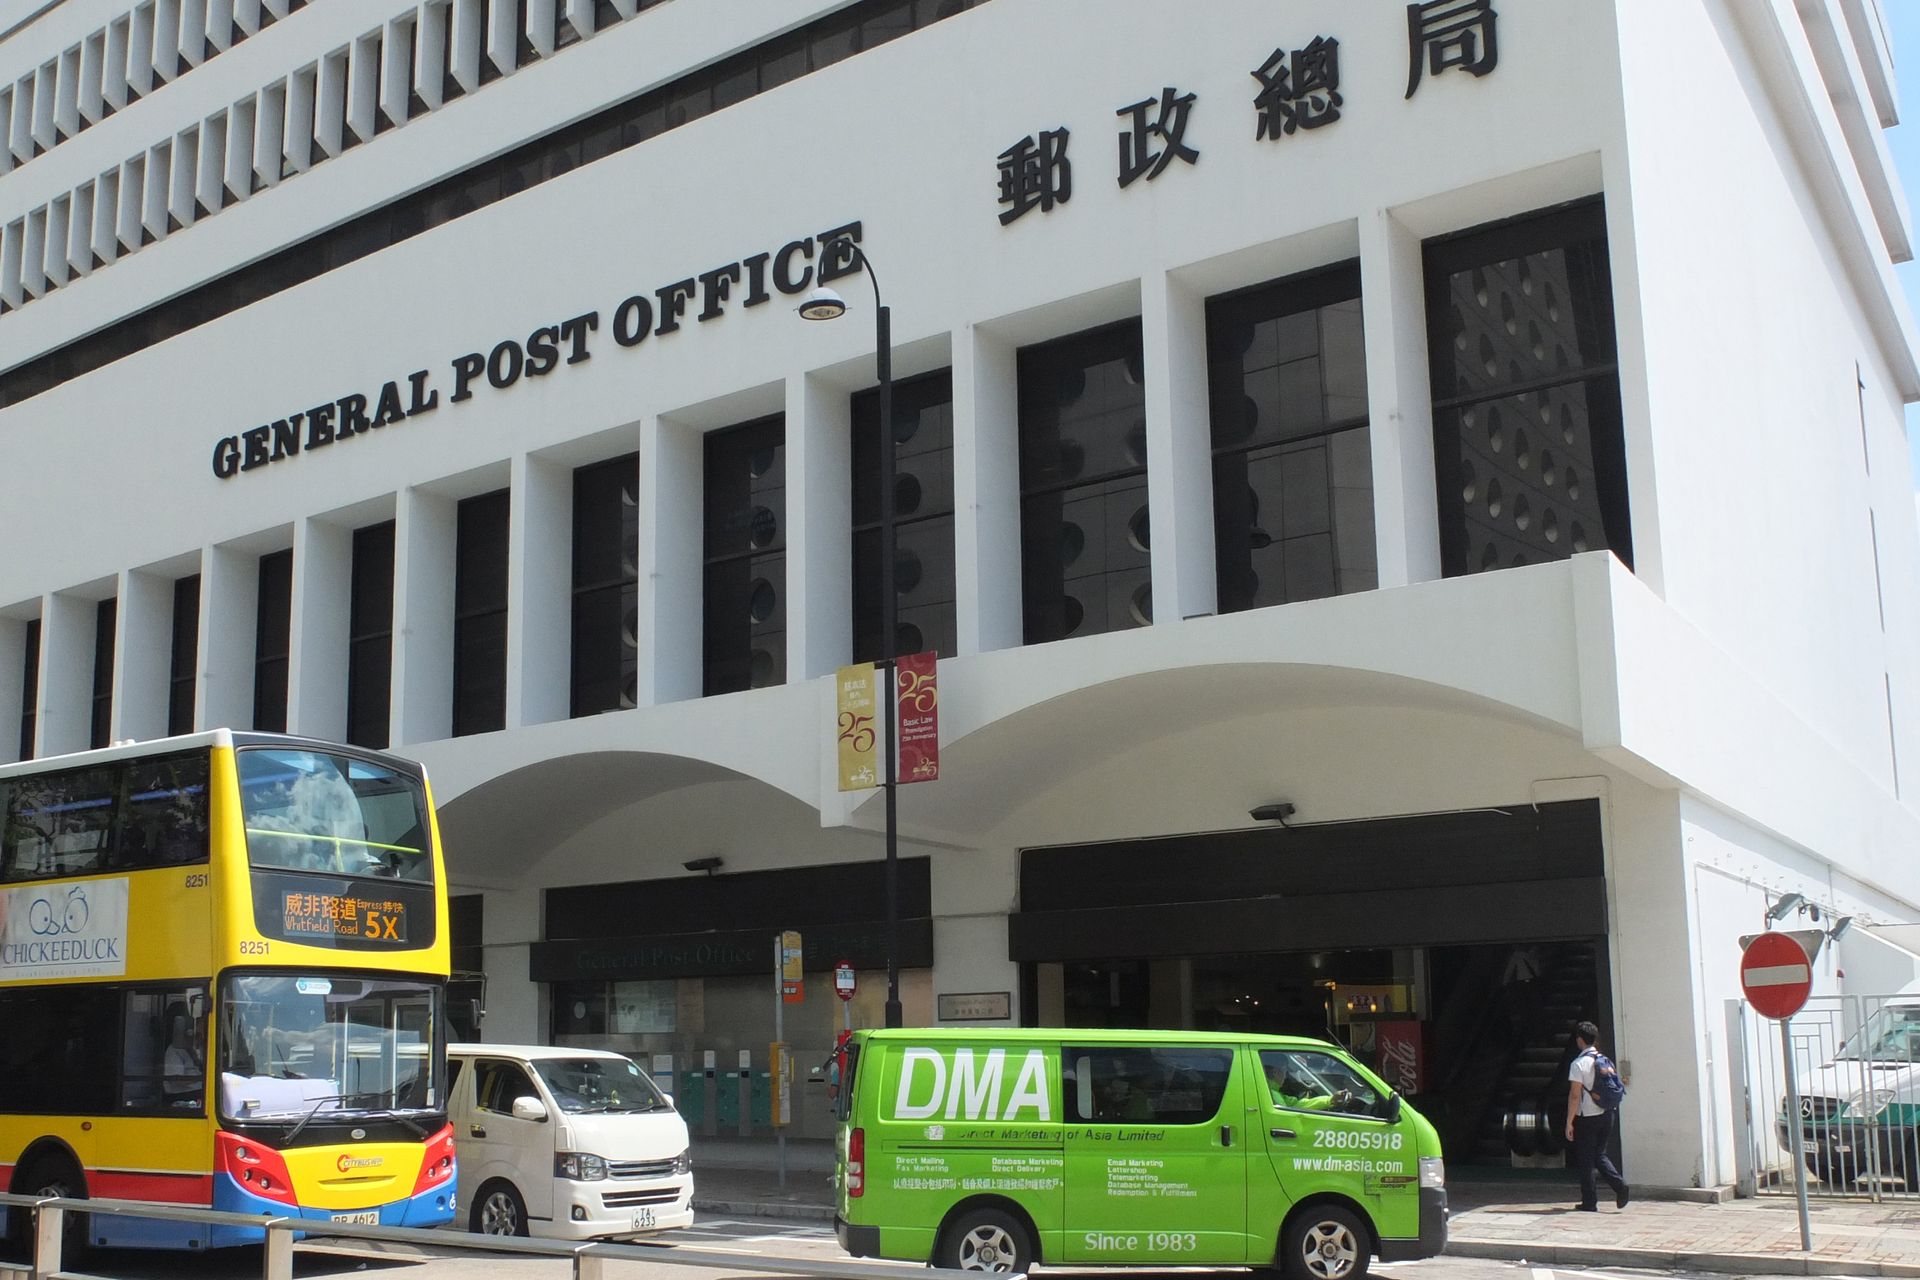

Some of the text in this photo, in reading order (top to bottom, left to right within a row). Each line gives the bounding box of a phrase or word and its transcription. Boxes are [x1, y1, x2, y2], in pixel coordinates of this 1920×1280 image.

[996, 0, 1498, 226] 郵政總局
[212, 220, 862, 479] GENERAL POST OFFICE
[898, 670, 937, 713] 25
[903, 716, 933, 727] Basic Law
[838, 711, 875, 753] 25
[185, 874, 209, 889] 8251
[285, 893, 357, 920] 威非路道
[357, 899, 382, 911] Express
[284, 915, 358, 935] Whitfield Road
[365, 911, 398, 940] 5X
[2, 937, 119, 965] CHICKEEDUCK
[240, 941, 270, 955] 8251
[893, 1047, 1050, 1121] DMA
[1067, 1130, 1079, 1140] of
[1085, 1129, 1112, 1140] Asia
[1118, 1130, 1165, 1141] Limited
[1313, 1130, 1402, 1150] 28805918
[914, 1165, 949, 1173] Marketing
[920, 1157, 945, 1166] Mailing
[992, 1157, 1063, 1167] Database Marketing
[1107, 1158, 1164, 1168] Email Marketing
[1293, 1155, 1403, 1173] www.dm-asia.com
[1017, 1165, 1046, 1174] Delivery
[1108, 1173, 1159, 1182] Telemarketing
[1107, 1181, 1189, 1190] Database Management
[353, 1213, 376, 1225] 4612
[1085, 1233, 1197, 1251] Since 1983
